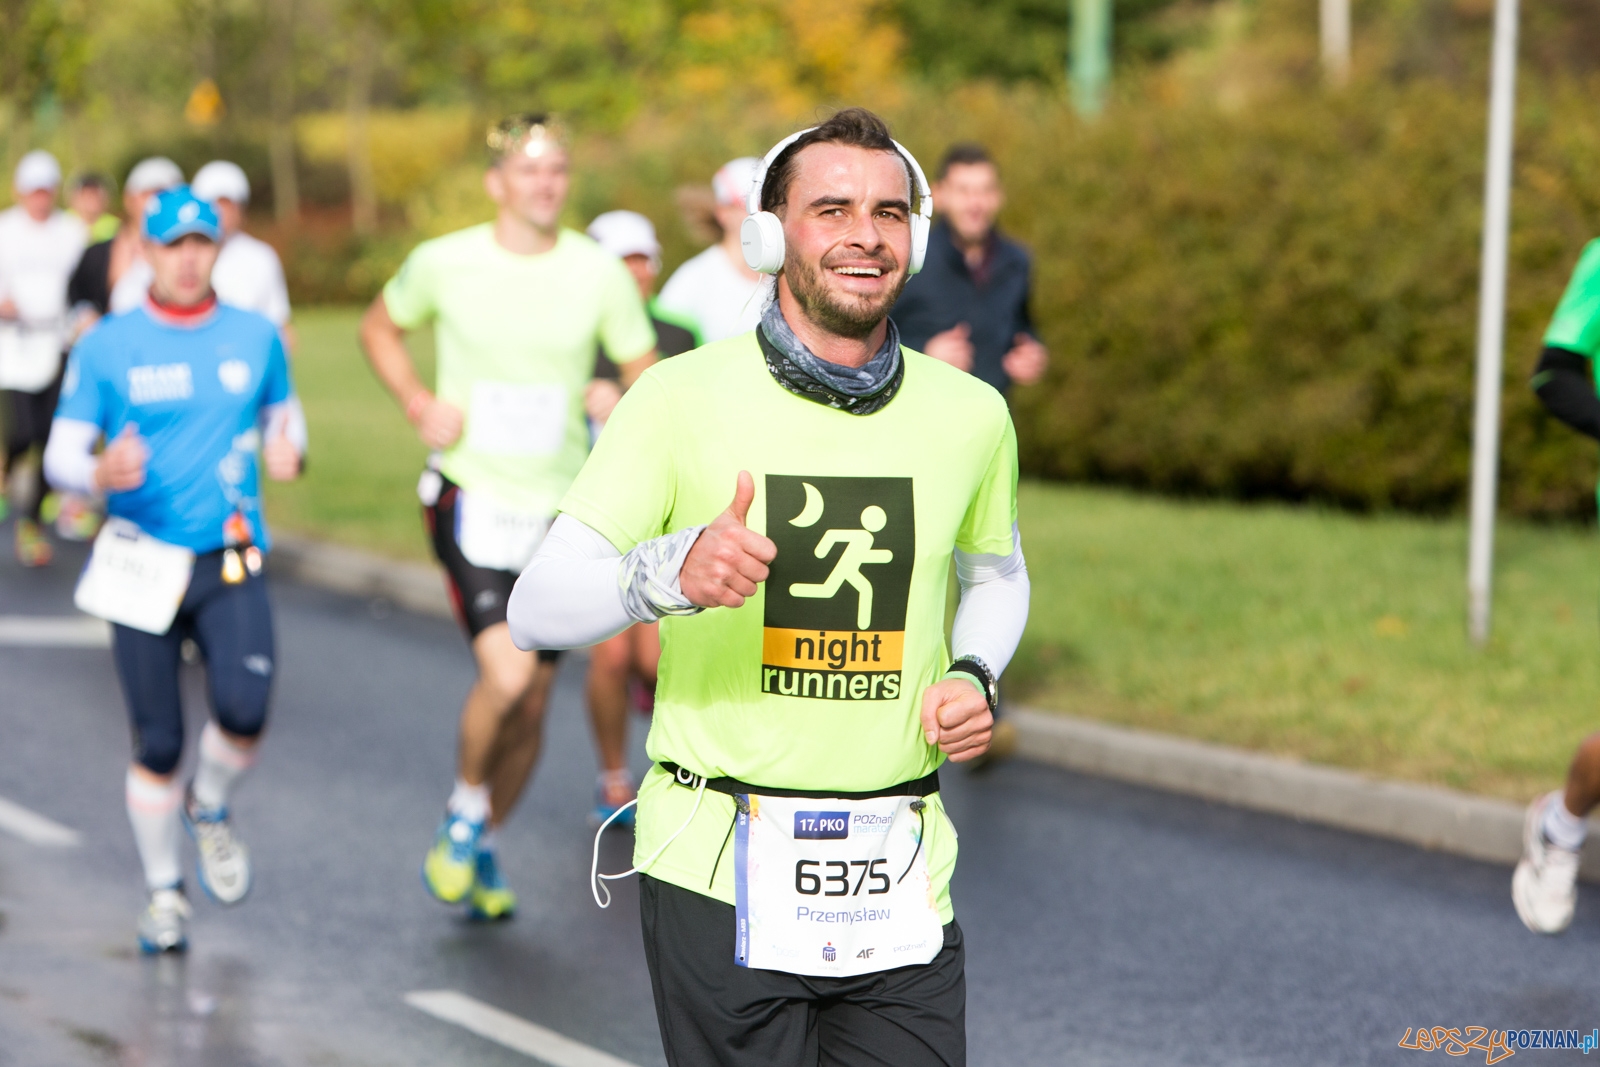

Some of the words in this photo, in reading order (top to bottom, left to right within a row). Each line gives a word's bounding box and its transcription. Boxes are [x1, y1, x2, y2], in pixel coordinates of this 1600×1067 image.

[794, 631, 882, 669] night
[763, 668, 900, 700] runners
[795, 858, 890, 896] 6375
[796, 906, 891, 925] Przemysław
